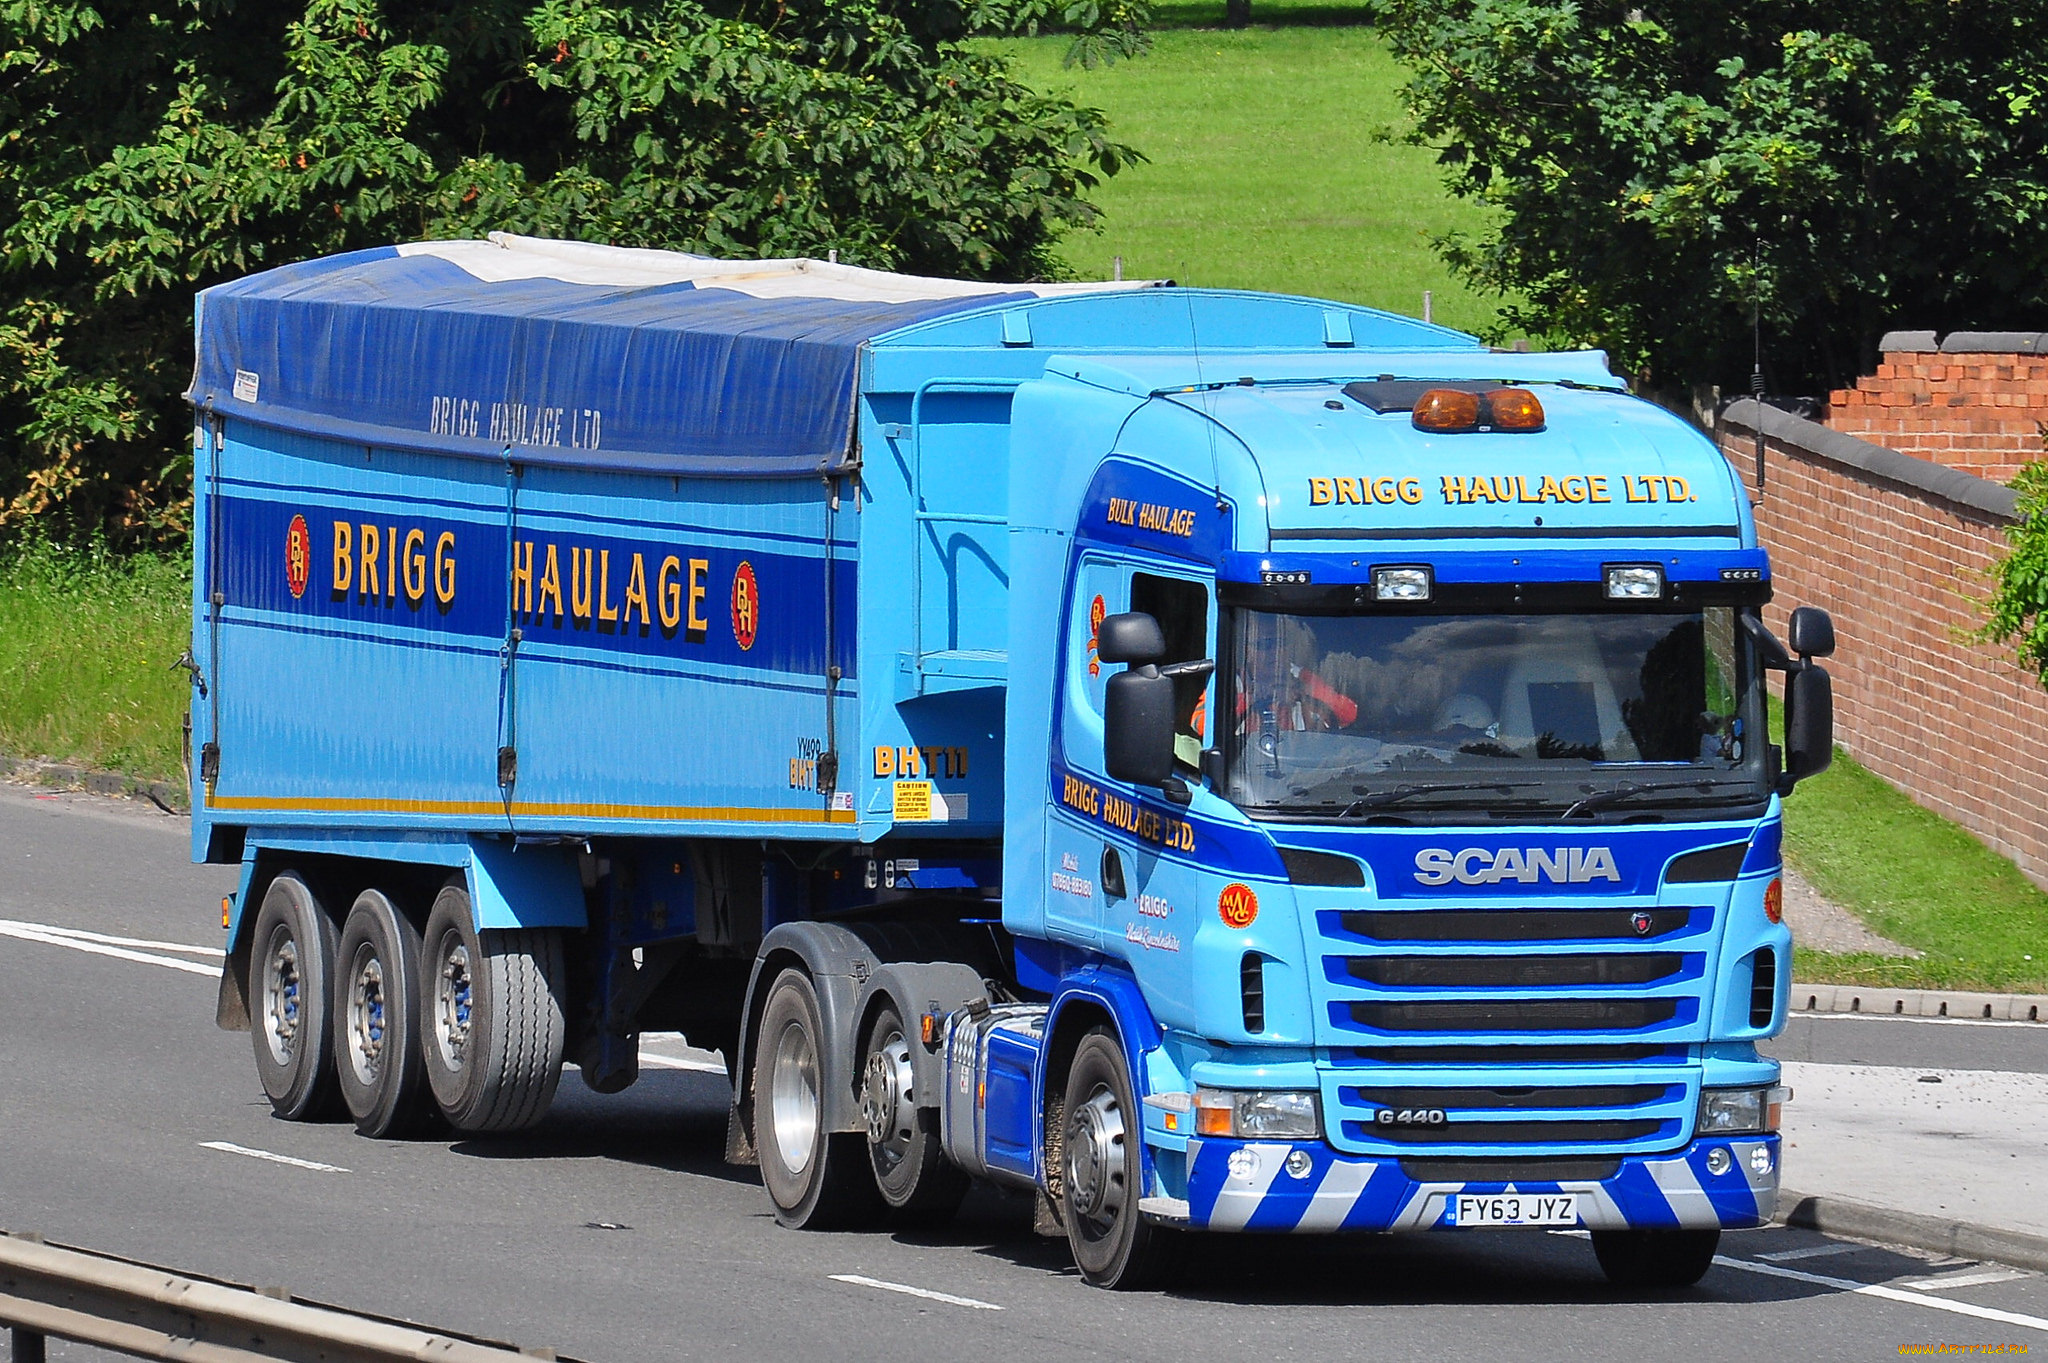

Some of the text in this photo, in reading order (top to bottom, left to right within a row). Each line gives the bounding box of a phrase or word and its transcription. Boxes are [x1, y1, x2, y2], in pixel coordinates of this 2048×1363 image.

[430, 396, 601, 450] BRIGG HAULAGE LTD
[1309, 475, 1699, 504] BRIGG HAULAGE LTD.
[1107, 497, 1196, 537] BULK HAULAGE
[332, 520, 709, 632] BRIGG HAULAGE
[873, 746, 968, 779] BHT11
[1063, 774, 1196, 853] BRIGG HAULAGE LTD.
[1413, 846, 1622, 886] SCANIA
[1378, 1109, 1444, 1124] G 440
[1460, 1199, 1572, 1221] FY63 JYZ
